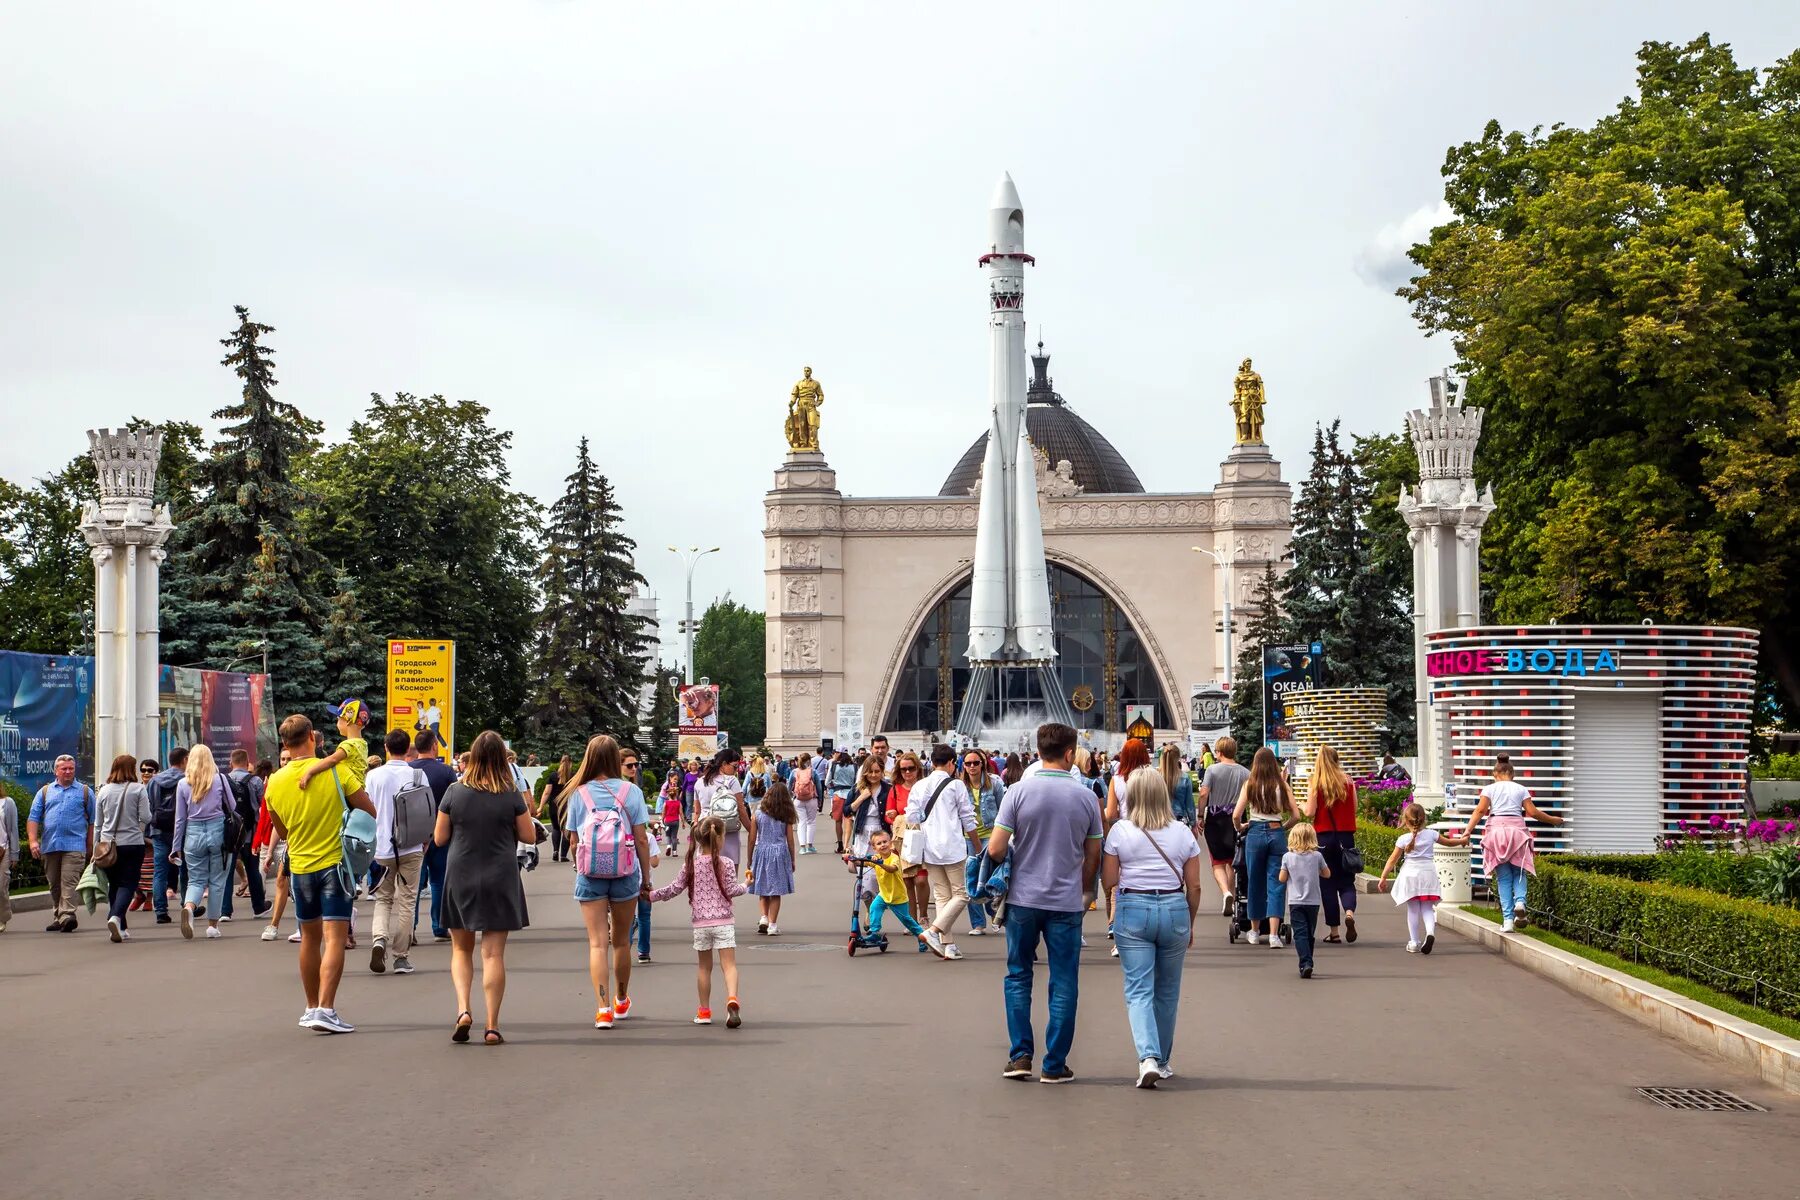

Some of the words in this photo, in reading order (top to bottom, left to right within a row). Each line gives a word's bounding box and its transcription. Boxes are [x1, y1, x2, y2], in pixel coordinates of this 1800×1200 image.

[1272, 681, 1314, 692] ОКЕАН
[27, 737, 49, 751] ВРЕМЯ
[26, 760, 55, 774] ВОЗРОЖ
